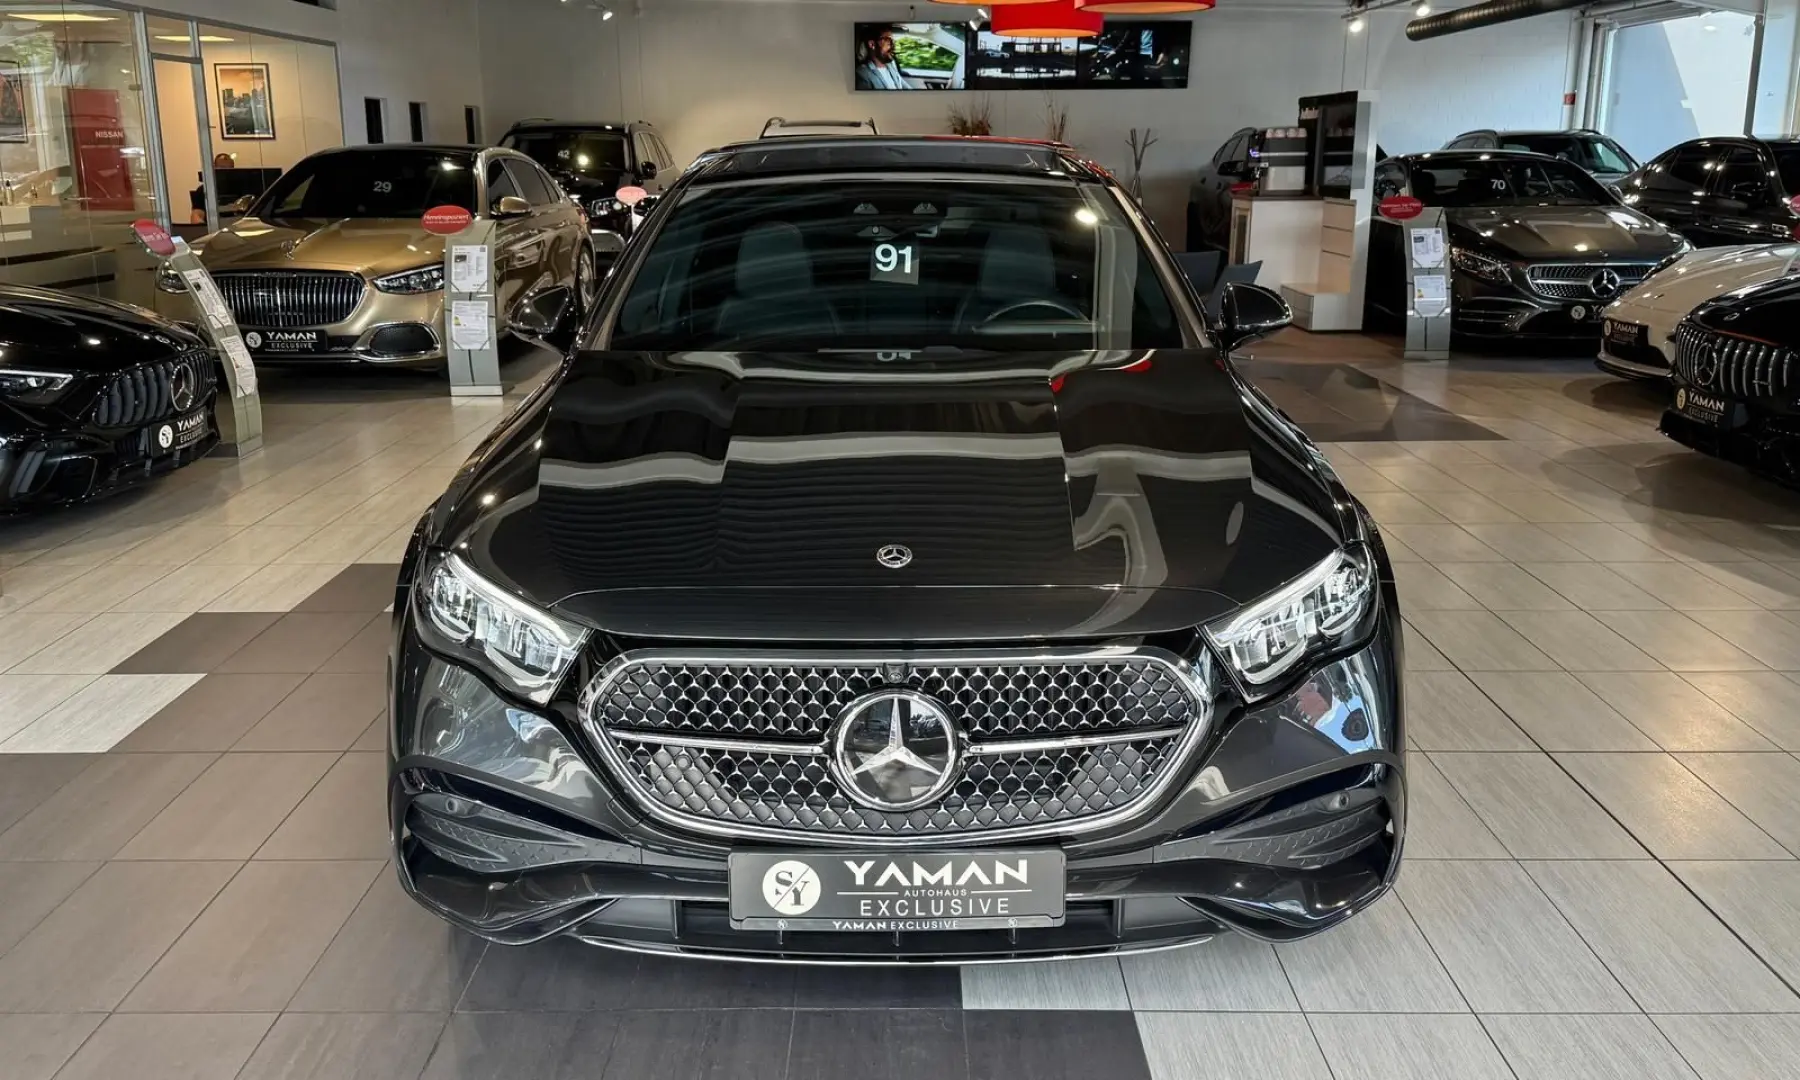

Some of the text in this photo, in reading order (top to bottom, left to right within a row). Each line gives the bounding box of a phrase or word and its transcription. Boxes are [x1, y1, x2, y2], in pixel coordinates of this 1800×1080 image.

[95, 130, 124, 138] NISSAN
[373, 181, 392, 193] 29
[1491, 179, 1505, 190] 70
[875, 243, 912, 274] 91
[266, 331, 317, 341] YAMAN
[1689, 391, 1725, 412] YAMAN
[177, 411, 204, 431] YAMAN
[843, 859, 1028, 887] YAMAN
[904, 888, 967, 898] AUTOHAUS
[860, 897, 1009, 917] EXCLUSIVE
[832, 920, 960, 931] YAMAN EXCLUSIVE
